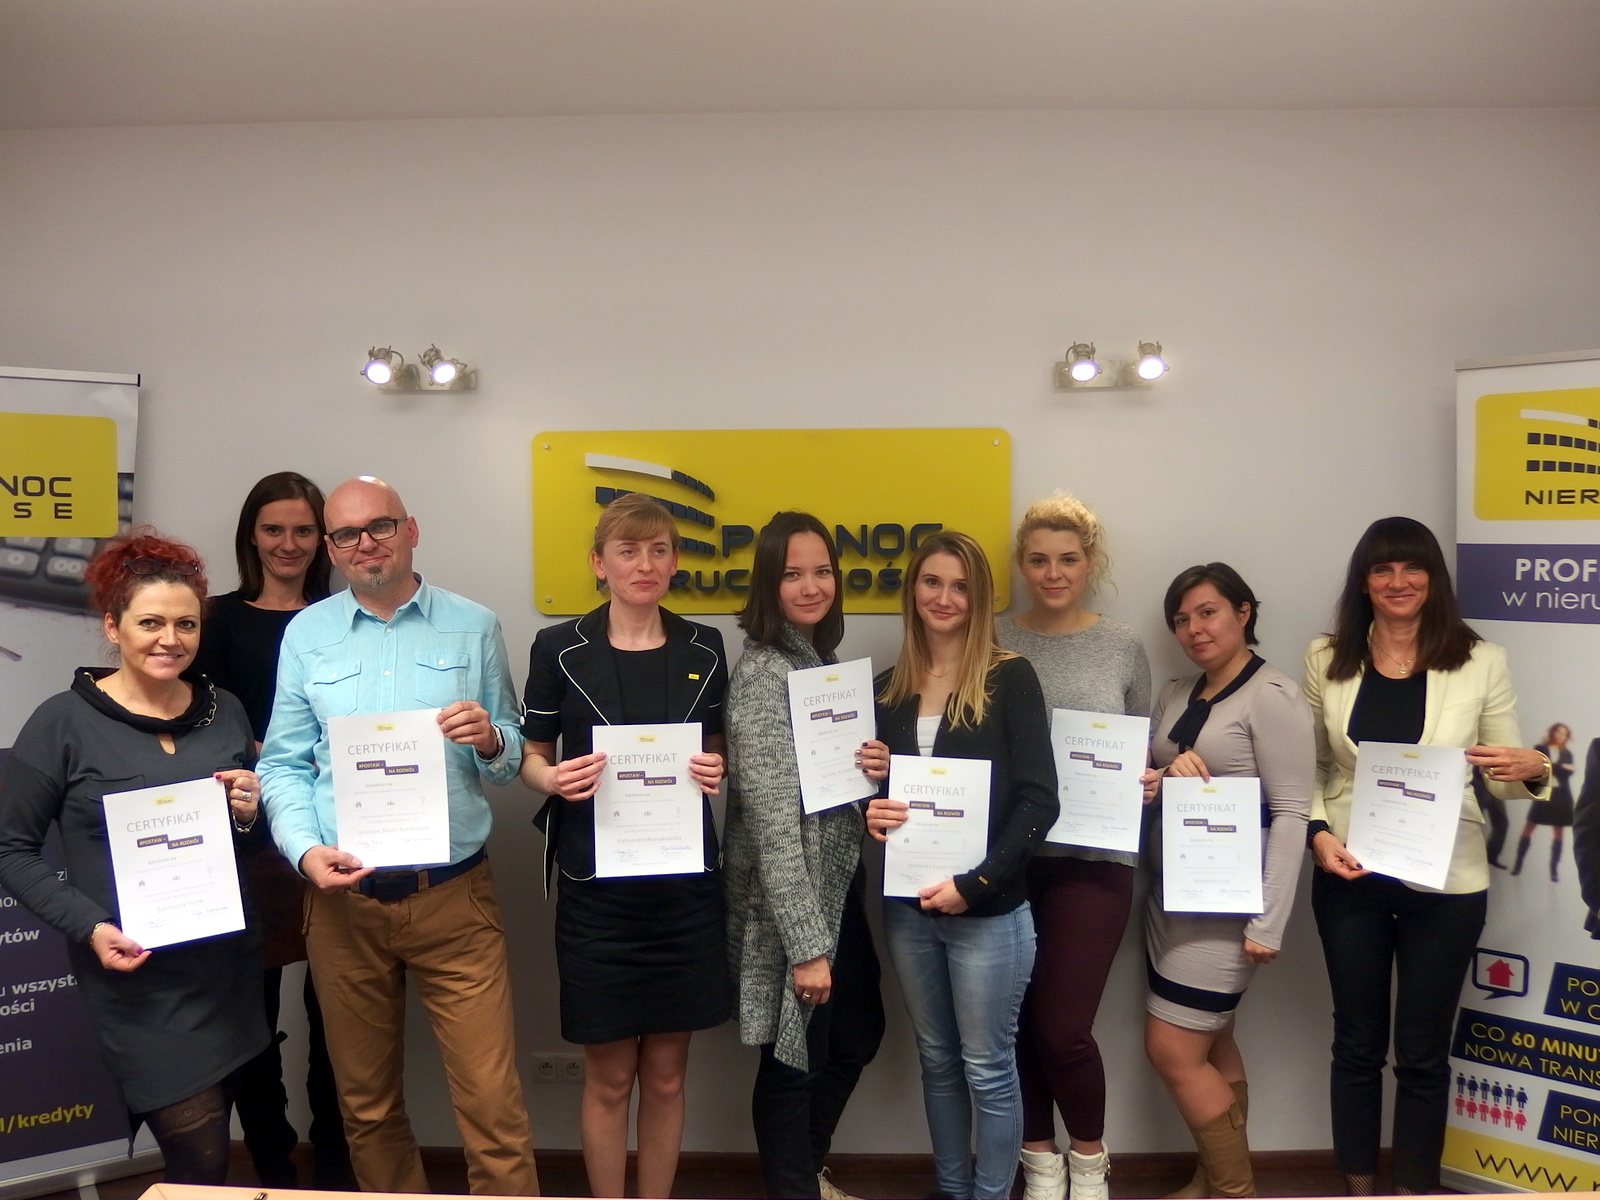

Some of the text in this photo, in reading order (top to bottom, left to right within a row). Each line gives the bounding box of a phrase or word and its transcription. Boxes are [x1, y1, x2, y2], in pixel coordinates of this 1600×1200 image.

[1502, 591, 1527, 607] w
[803, 688, 857, 707] CERTYFIKAT
[347, 740, 418, 756] CERTYFIKAT
[1064, 735, 1125, 750] CERTYFIKAT
[609, 752, 678, 766] CERTYFIKAT
[1371, 765, 1440, 781] CERTYFIKAT
[903, 784, 966, 797] CERTYFIKAT
[1176, 803, 1237, 813] CERTYFIKAT
[126, 810, 201, 833] CERTYFIKAT
[1470, 1022, 1505, 1042] CO
[1511, 1031, 1536, 1049] 60
[1464, 1041, 1533, 1071] NOWA
[1552, 1124, 1599, 1150] NIER
